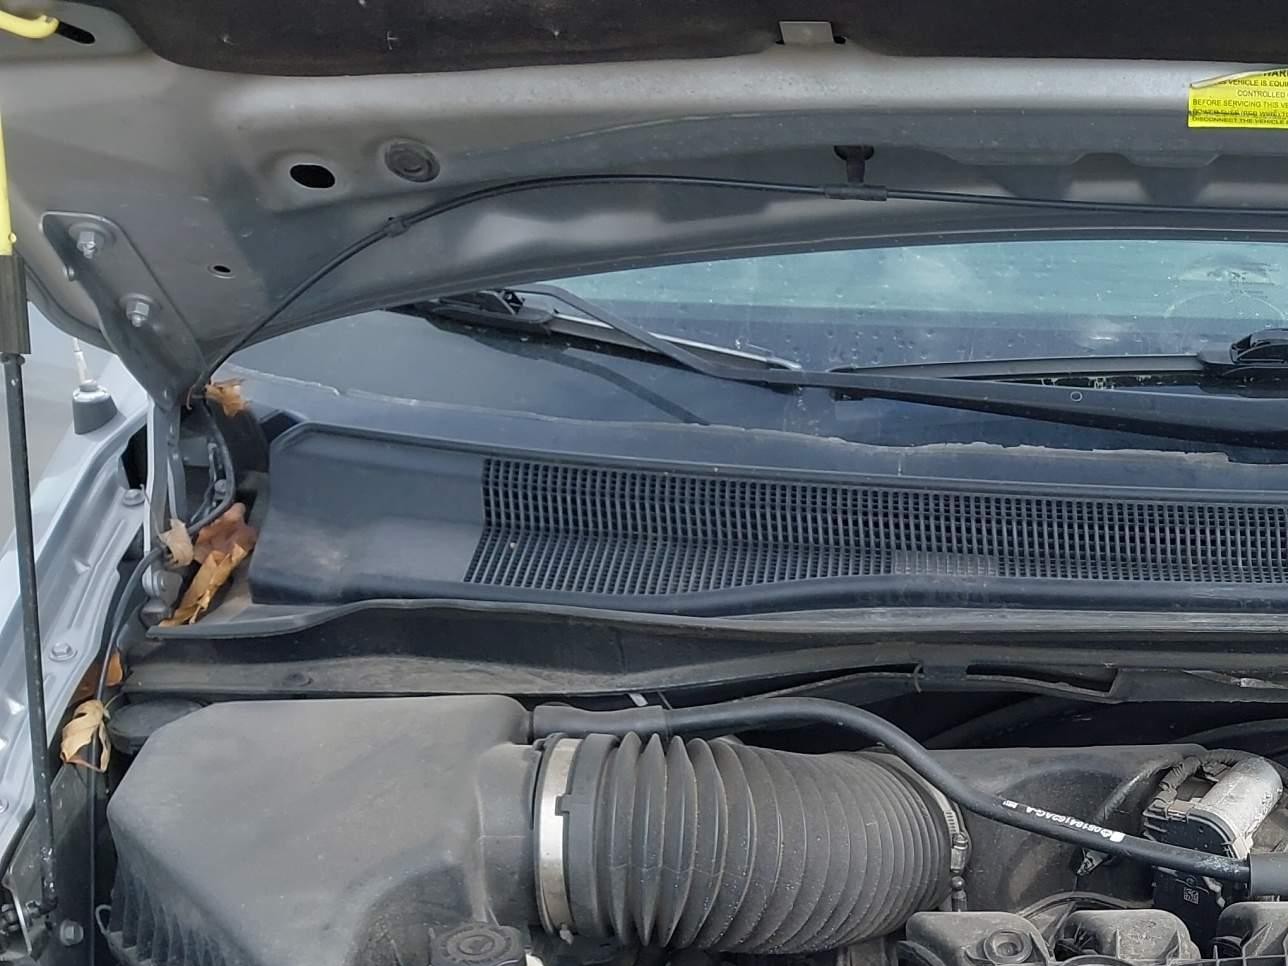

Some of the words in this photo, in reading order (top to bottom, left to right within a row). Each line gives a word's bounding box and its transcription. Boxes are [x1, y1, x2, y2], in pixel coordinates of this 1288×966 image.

[1229, 79, 1258, 88] VEHICLE
[1237, 90, 1286, 99] CONTROLLED
[1192, 98, 1222, 107] BEFORE
[1223, 99, 1261, 108] SERVICING
[1263, 100, 1279, 108] THIS
[1255, 117, 1284, 125] VEHICLE
